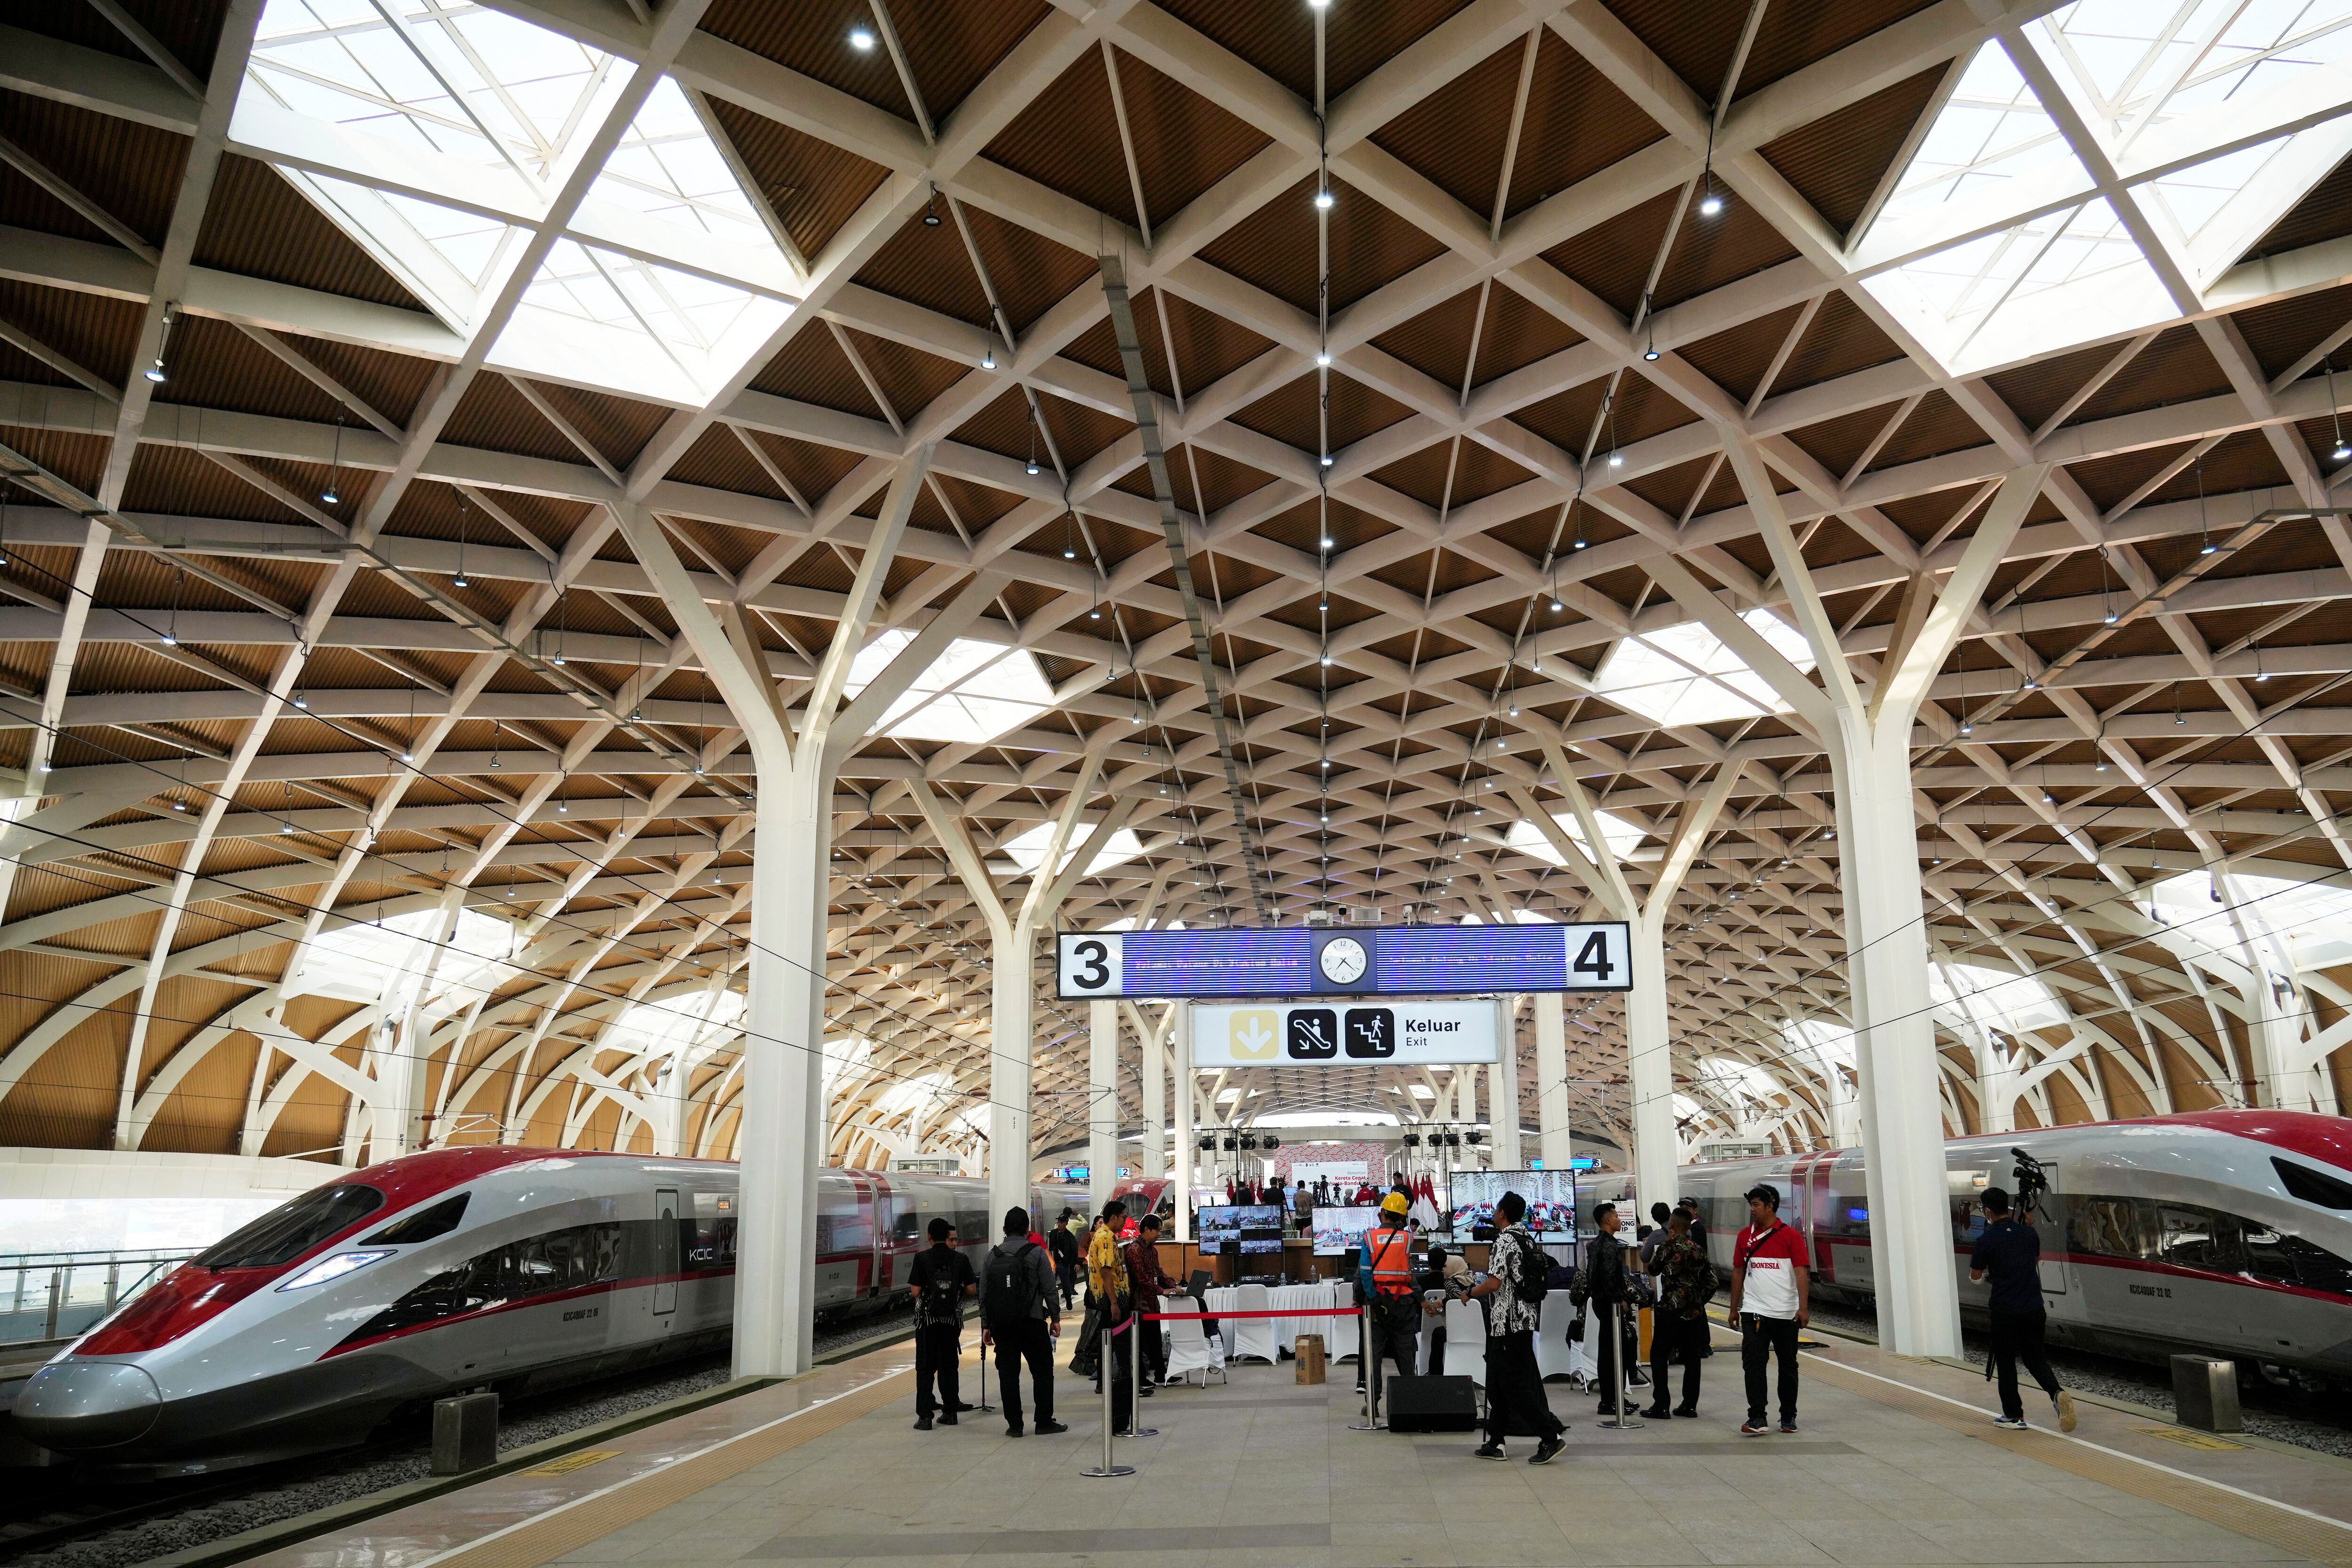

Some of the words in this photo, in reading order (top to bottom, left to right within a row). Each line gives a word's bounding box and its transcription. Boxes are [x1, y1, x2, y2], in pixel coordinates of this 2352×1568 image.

[1574, 931, 1613, 980] 4
[1073, 940, 1109, 989] 3
[1406, 1019, 1461, 1032] Keluar
[1406, 1037, 1427, 1046] Exit
[689, 1248, 713, 1261] KCIC
[2130, 1284, 2155, 1296] KCIC400AF
[2157, 1287, 2163, 1297] 22
[2165, 1288, 2171, 1298] 02
[563, 1310, 586, 1321] KCIC400AF
[587, 1309, 592, 1318] 22
[593, 1308, 598, 1317] 06
